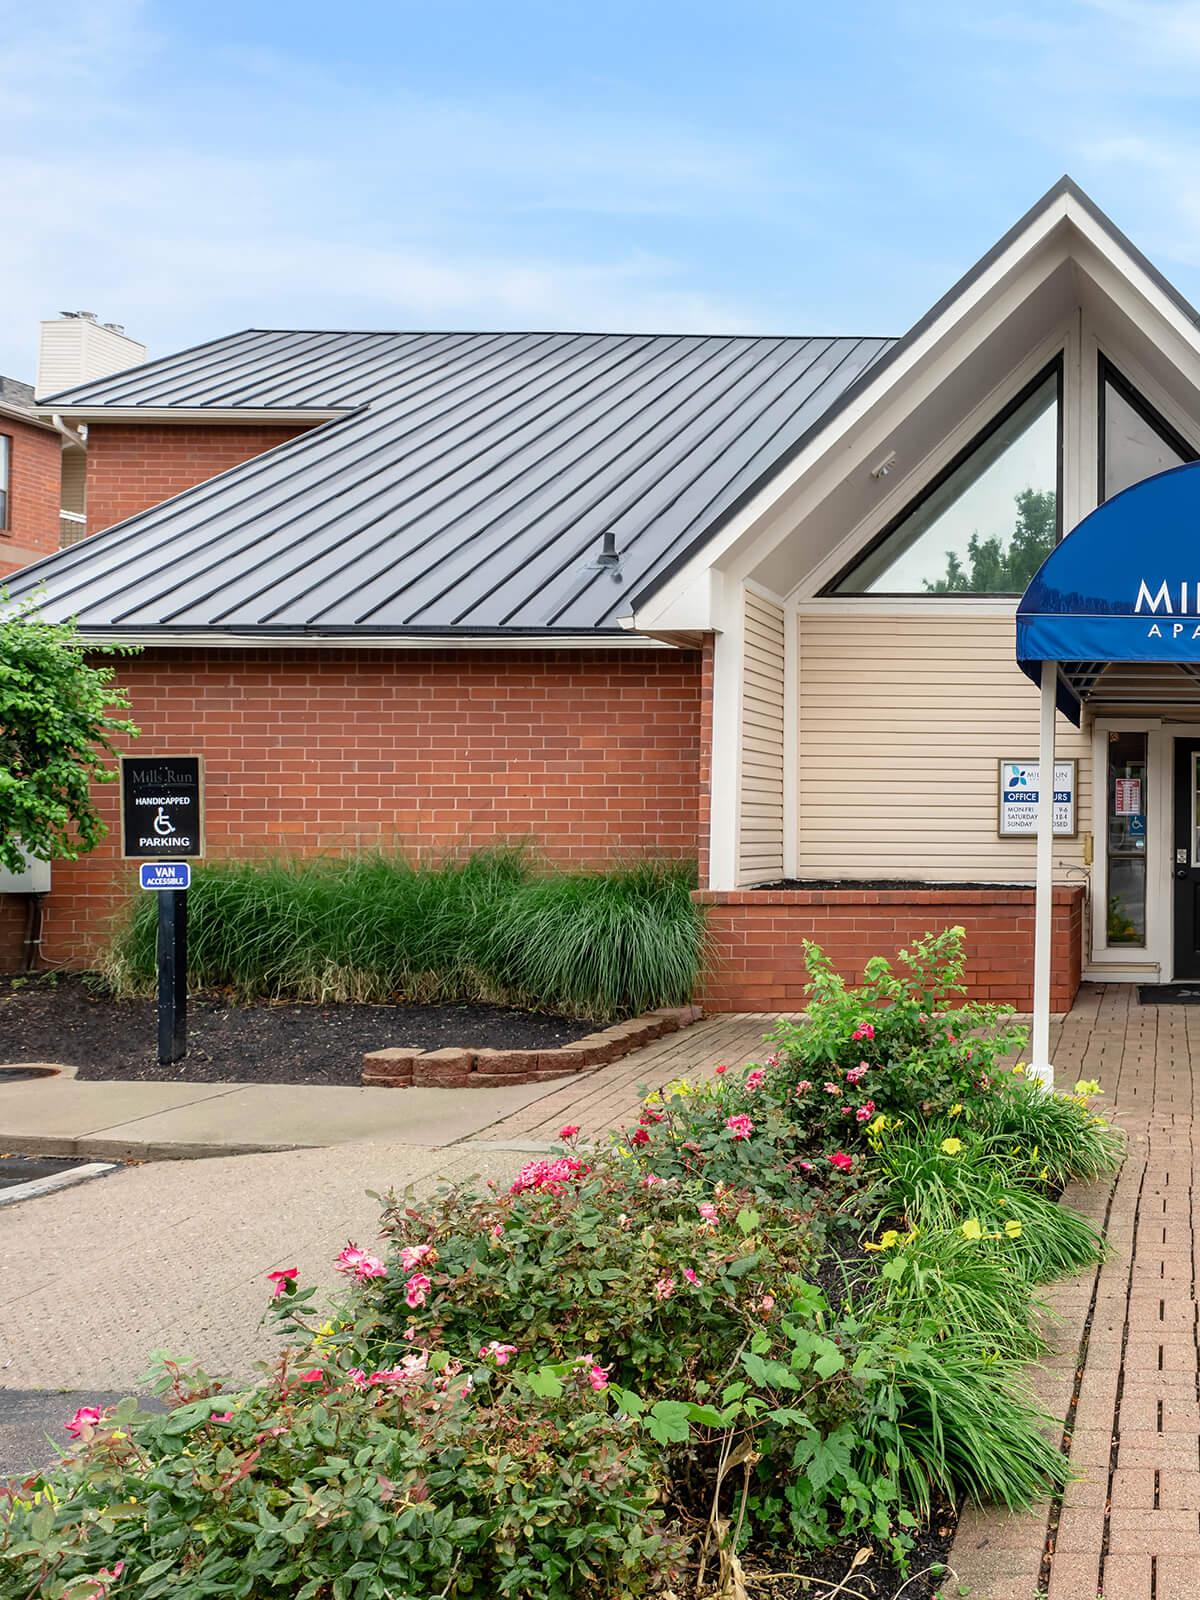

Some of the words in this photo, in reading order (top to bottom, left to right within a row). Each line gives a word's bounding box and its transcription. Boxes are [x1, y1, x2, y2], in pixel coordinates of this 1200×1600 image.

[132, 770, 162, 783] Mills
[166, 771, 193, 783] Run
[135, 797, 190, 805] HANDICAPPED
[1008, 793, 1037, 801] OFFICE
[1053, 793, 1068, 801] URS
[139, 837, 190, 847] PARKING
[154, 867, 176, 878] VAN
[146, 877, 184, 885] ACCESSIBLE
